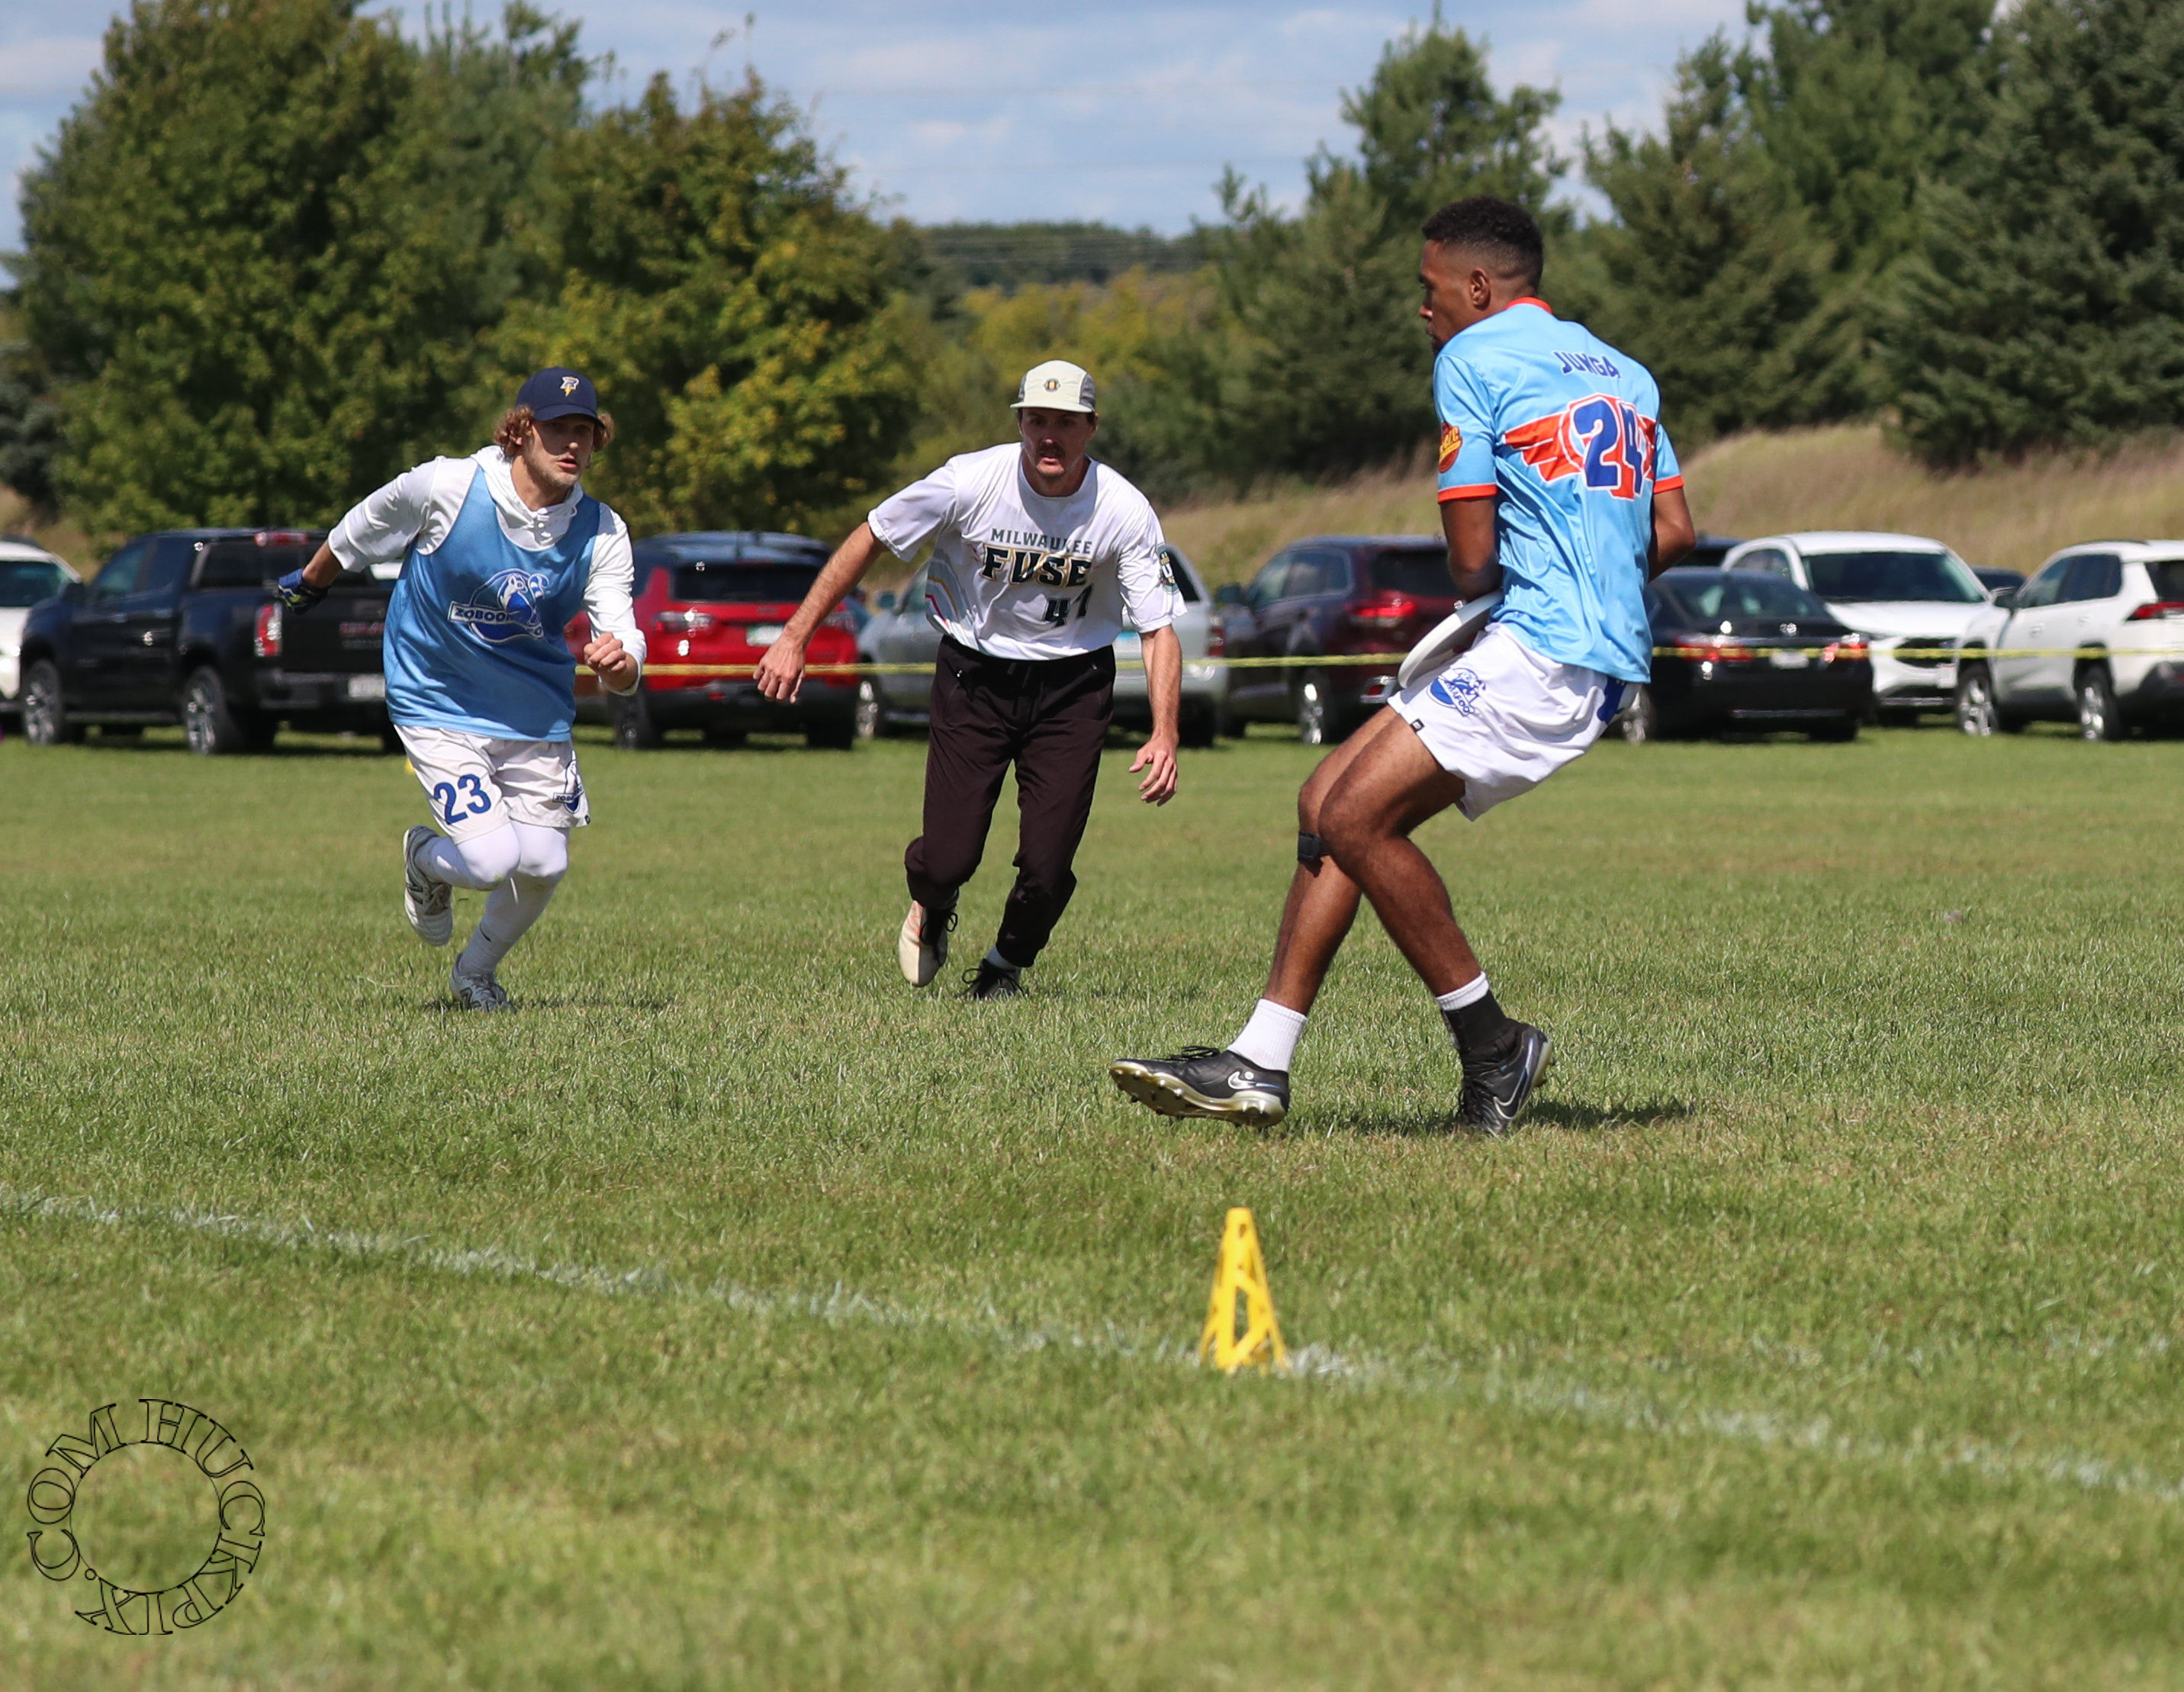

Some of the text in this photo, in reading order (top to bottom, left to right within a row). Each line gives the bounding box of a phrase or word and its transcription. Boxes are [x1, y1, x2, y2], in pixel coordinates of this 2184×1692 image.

[1572, 397, 1643, 495] 24
[980, 545, 1092, 587] FUSE
[433, 773, 492, 825] 23
